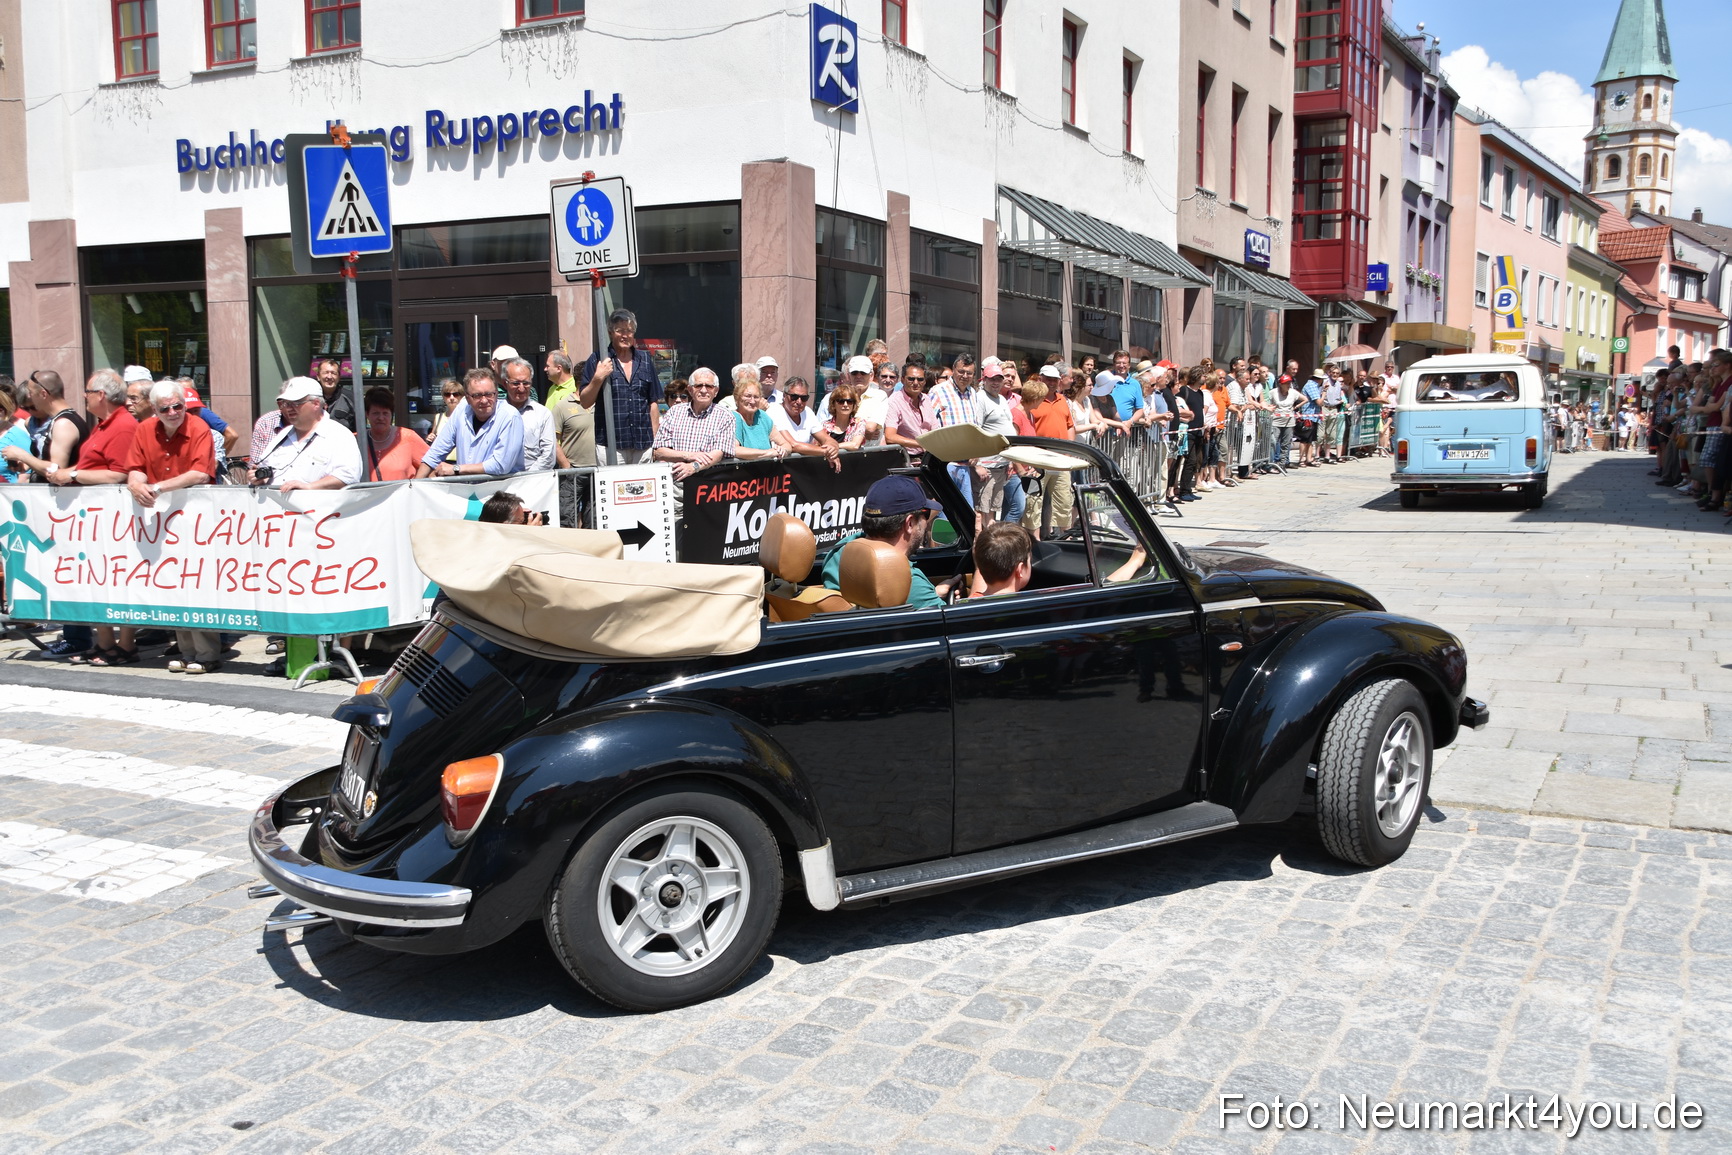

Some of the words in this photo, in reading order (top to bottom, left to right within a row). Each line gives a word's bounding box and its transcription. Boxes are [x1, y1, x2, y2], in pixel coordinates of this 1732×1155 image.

[176, 118, 410, 173] Buchhag
[426, 89, 624, 155] Rupprecht
[575, 249, 612, 266] ZONE
[1249, 232, 1270, 256] CECIL
[1497, 292, 1512, 307] B
[599, 480, 609, 529] RESIDE
[696, 474, 792, 505] FAHRSCHULE
[112, 509, 185, 545] UNS
[661, 475, 672, 563] RESIDENZPLA
[722, 543, 760, 560] Neumarkt
[216, 556, 387, 596] BESSER.
[106, 607, 180, 622] Service-Line:
